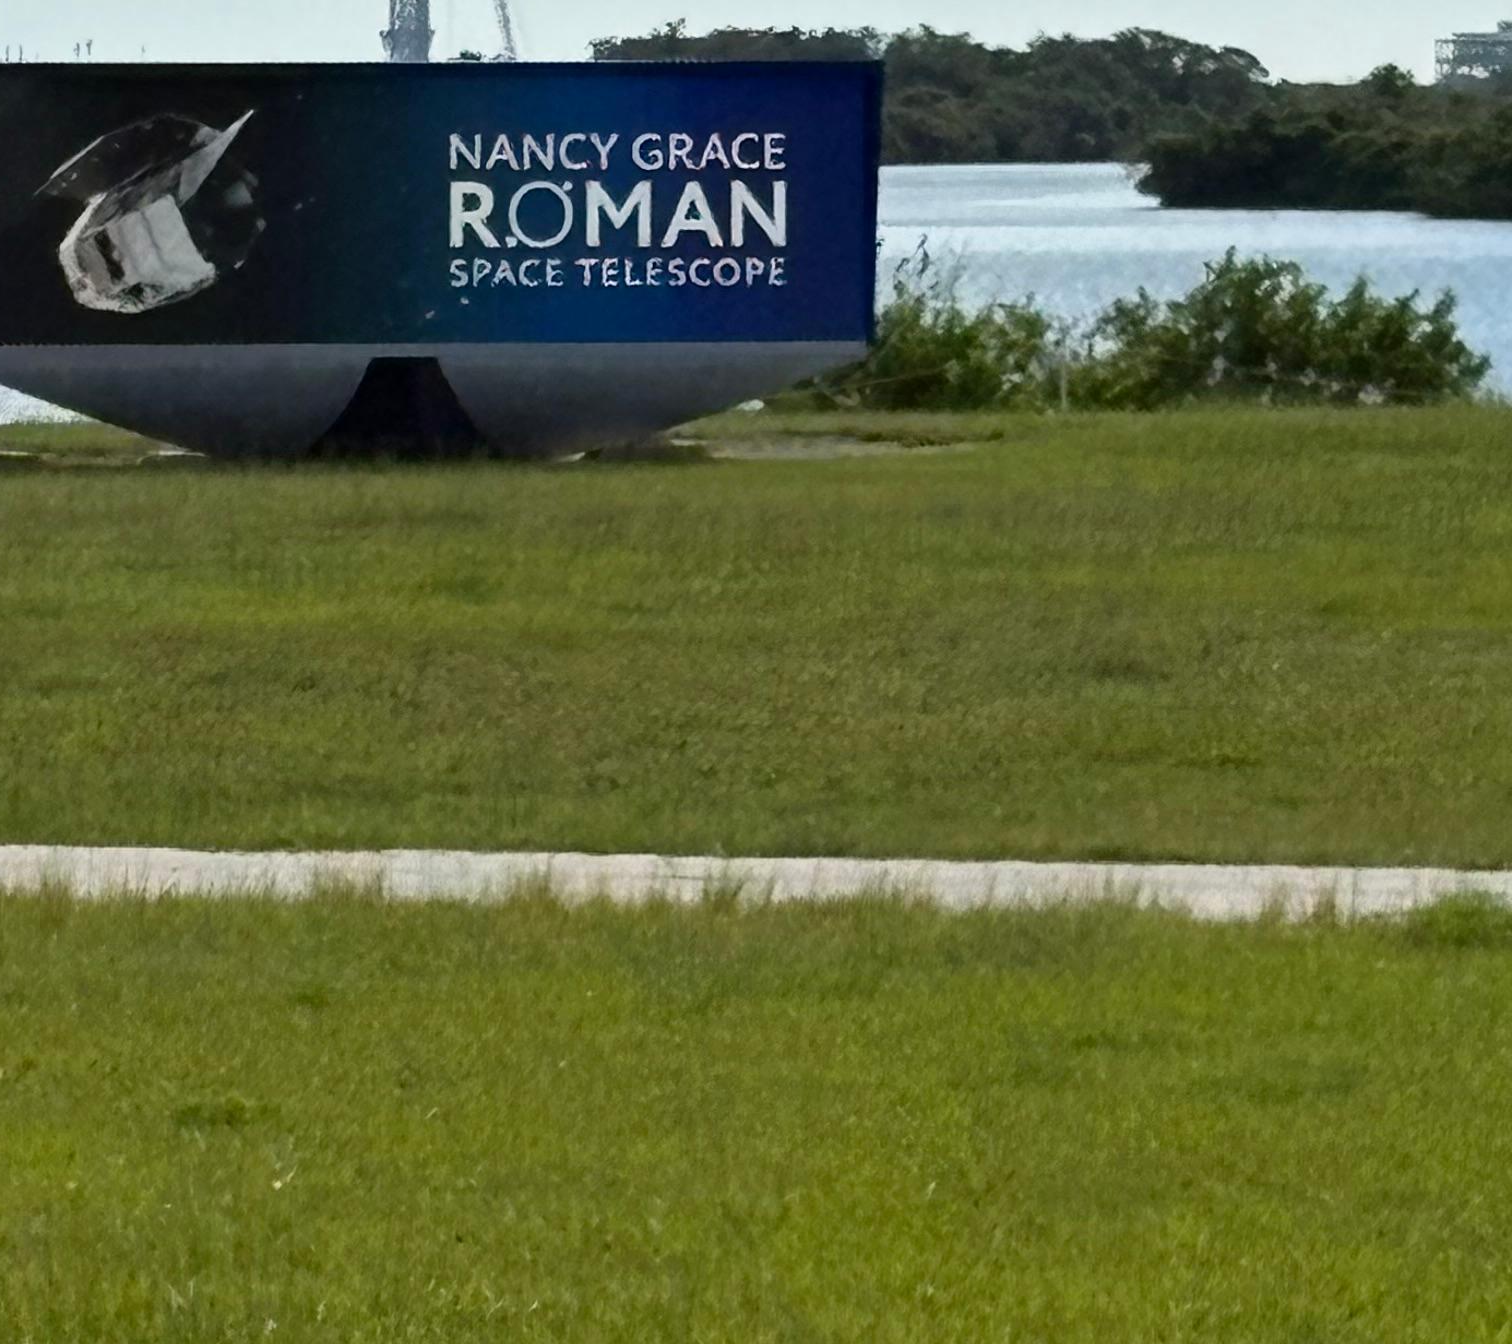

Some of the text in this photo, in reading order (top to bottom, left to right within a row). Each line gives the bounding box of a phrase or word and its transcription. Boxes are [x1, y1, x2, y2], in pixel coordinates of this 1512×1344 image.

[449, 133, 787, 171] NANCY GRACE
[449, 180, 788, 248] ROMAN
[449, 257, 788, 288] SPACE TELESCOPE
